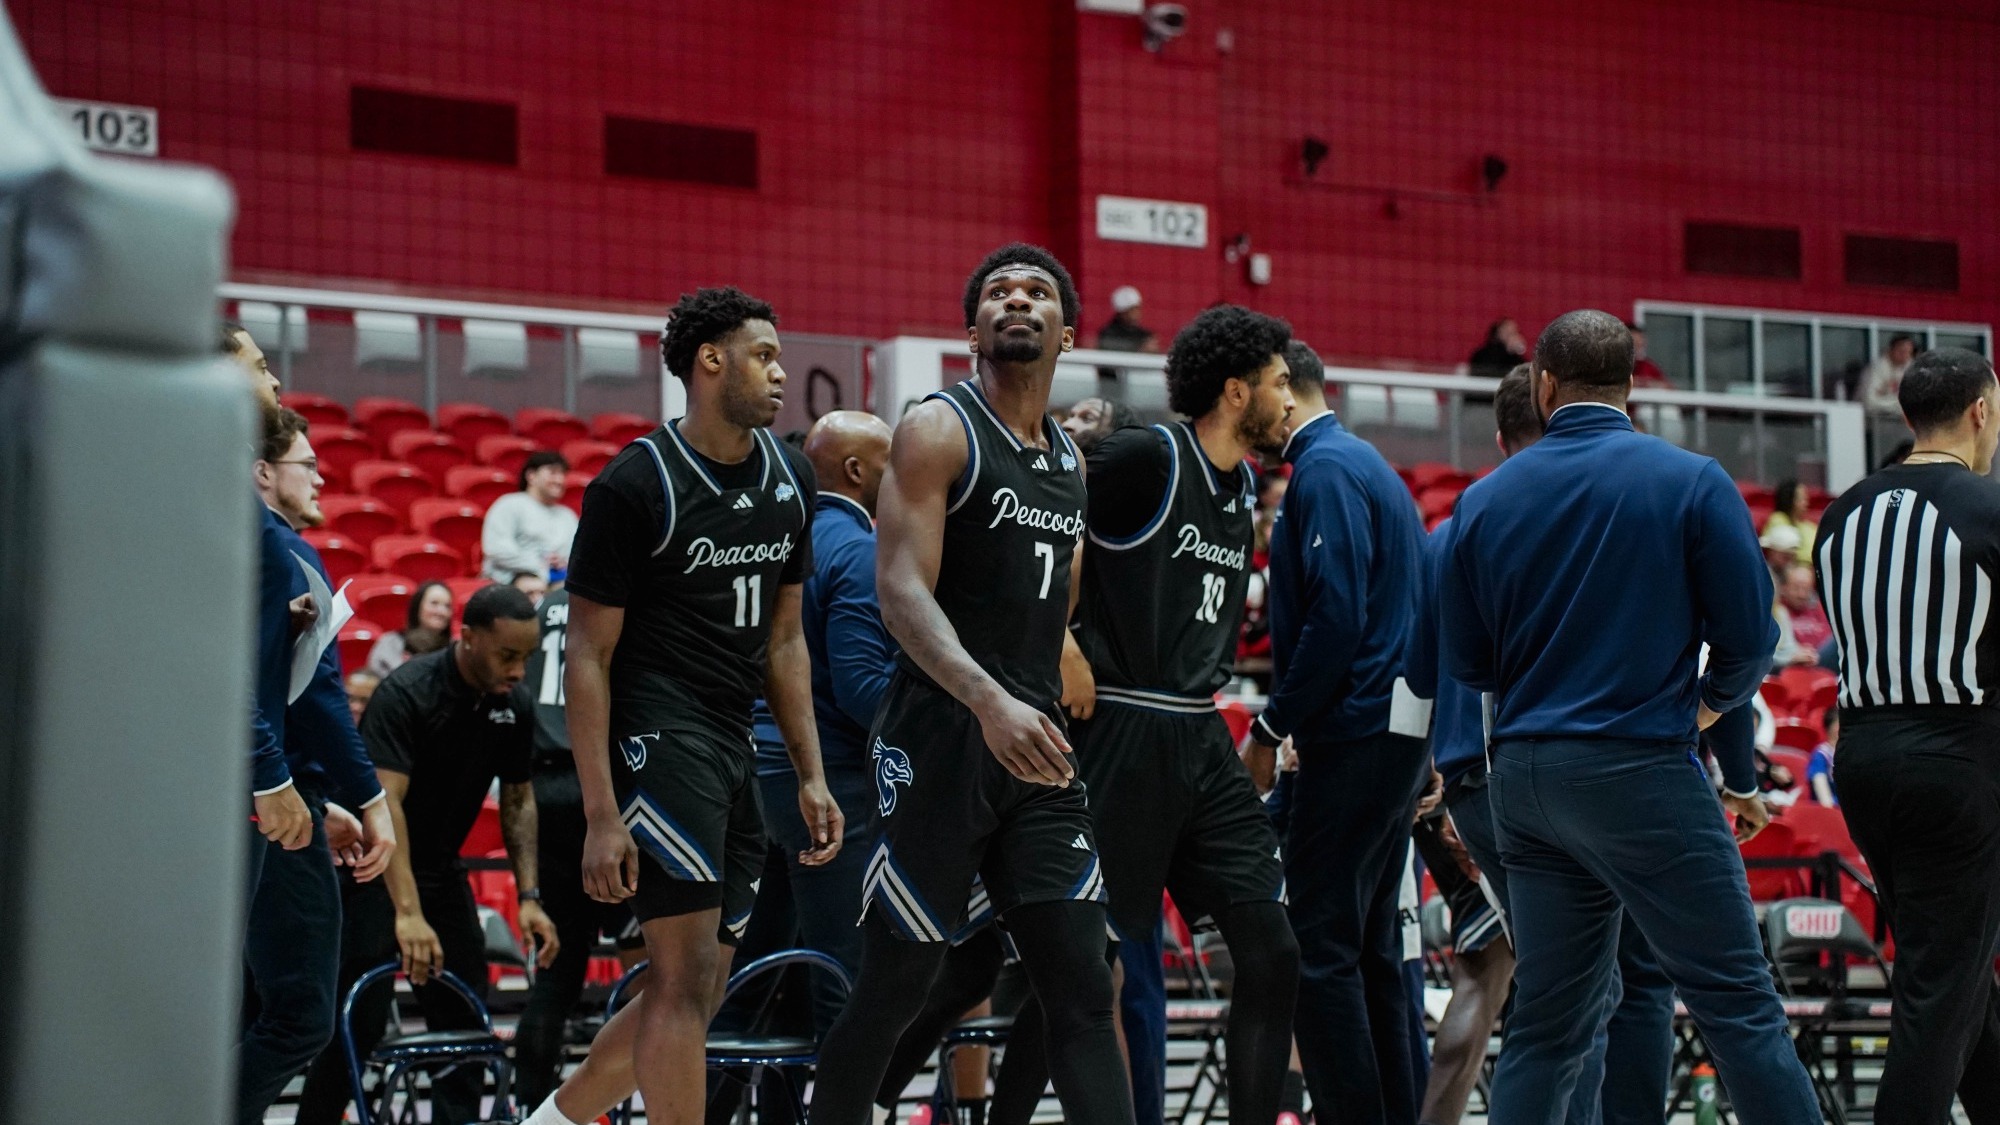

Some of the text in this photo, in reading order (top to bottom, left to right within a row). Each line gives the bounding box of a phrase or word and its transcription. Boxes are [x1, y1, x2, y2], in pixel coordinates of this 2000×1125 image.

[72, 108, 149, 147] 103
[1147, 208, 1198, 236] 102
[988, 487, 1086, 541] Peacock
[1035, 541, 1055, 600] 7
[732, 574, 761, 628] 11
[1195, 572, 1226, 625] 10
[1790, 910, 1838, 933] SHU
